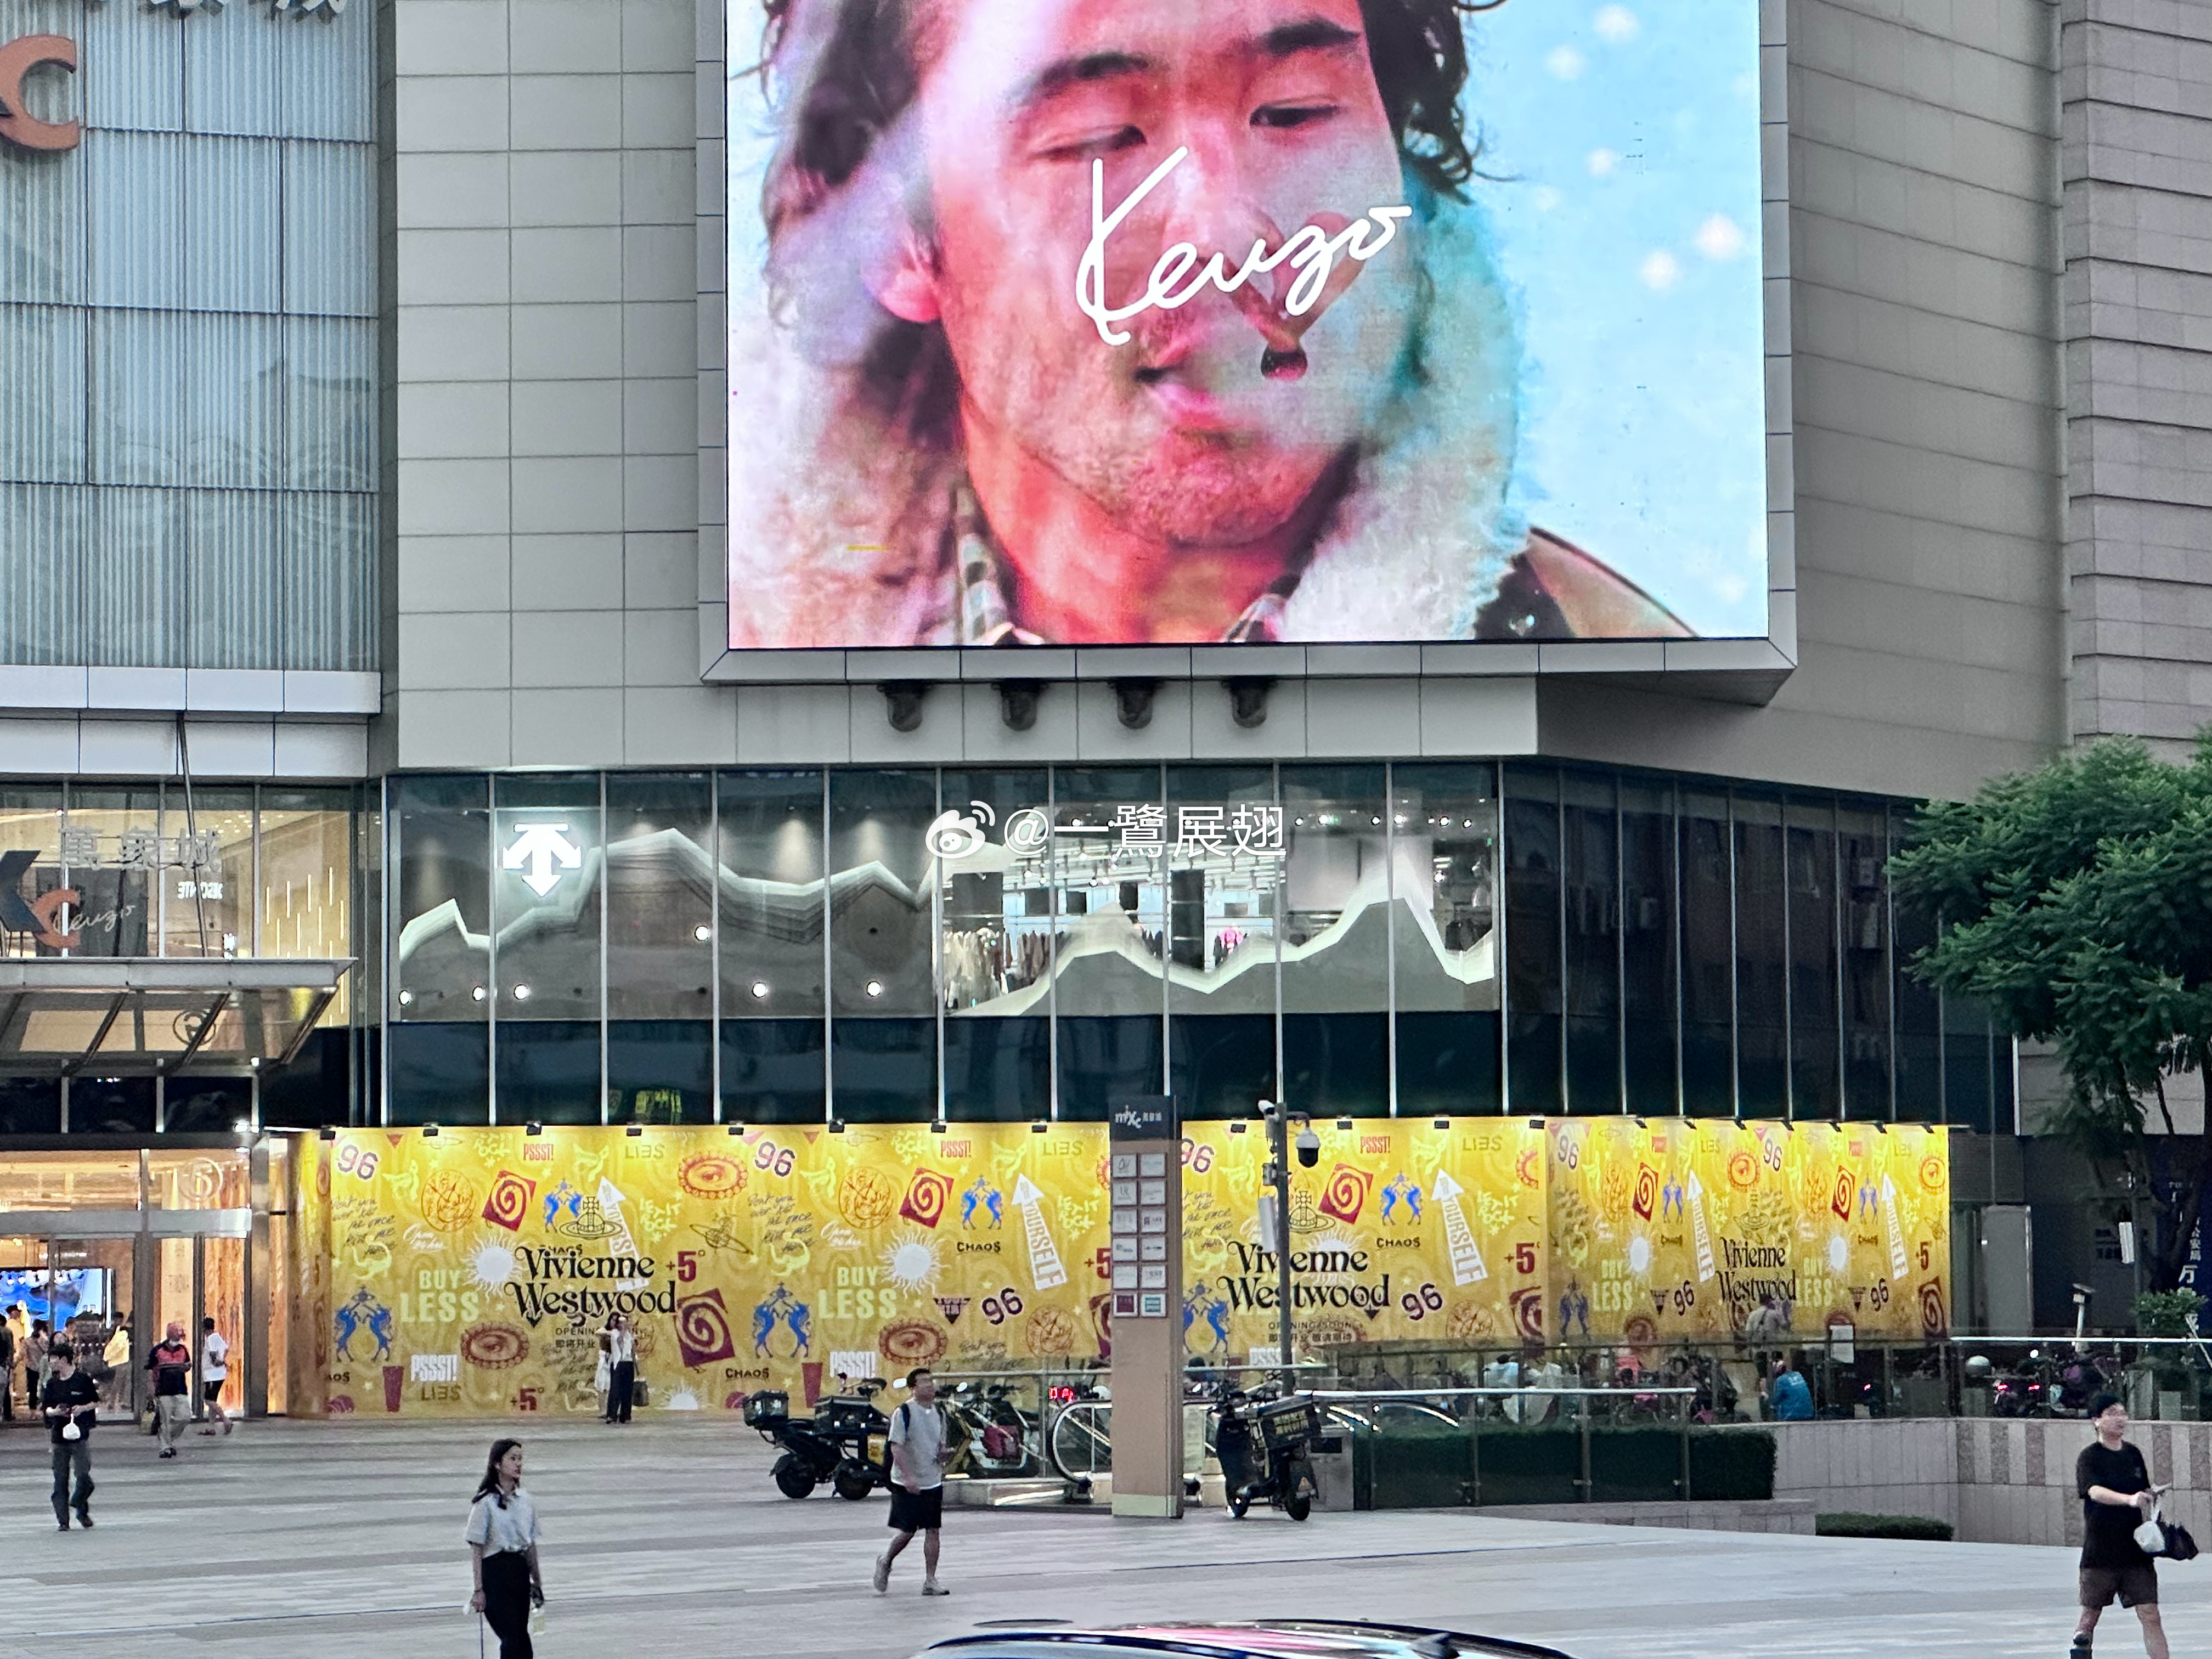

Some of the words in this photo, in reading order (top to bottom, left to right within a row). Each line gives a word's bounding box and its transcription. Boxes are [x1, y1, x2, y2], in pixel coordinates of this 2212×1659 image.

[338, 1144, 379, 1180] 96
[523, 1143, 554, 1161] PSSST!
[754, 1141, 795, 1177] 96
[941, 1139, 971, 1158] PSSST!
[1360, 1136, 1391, 1154] PSSST!
[957, 1241, 1001, 1253] CHAOS
[1024, 1201, 1065, 1285] YOURSELF
[1376, 1237, 1421, 1248] CHAOS
[1443, 1198, 1485, 1282] YOURSELF
[1719, 1235, 1786, 1269] Vivienne
[514, 1246, 655, 1280] Vivienne
[1227, 1240, 1368, 1275] Vivenne
[419, 1269, 461, 1290] BUY
[837, 1266, 879, 1287] BUY
[1715, 1269, 1797, 1303] Westwood
[400, 1291, 480, 1323] LESS
[504, 1280, 676, 1317] Westwood
[817, 1289, 898, 1319] LESS
[982, 1287, 1023, 1325] 96
[1402, 1283, 1443, 1321] 96
[1674, 1280, 1695, 1316] 96
[1870, 1278, 1889, 1312] 96
[725, 1368, 770, 1379] CHAOS
